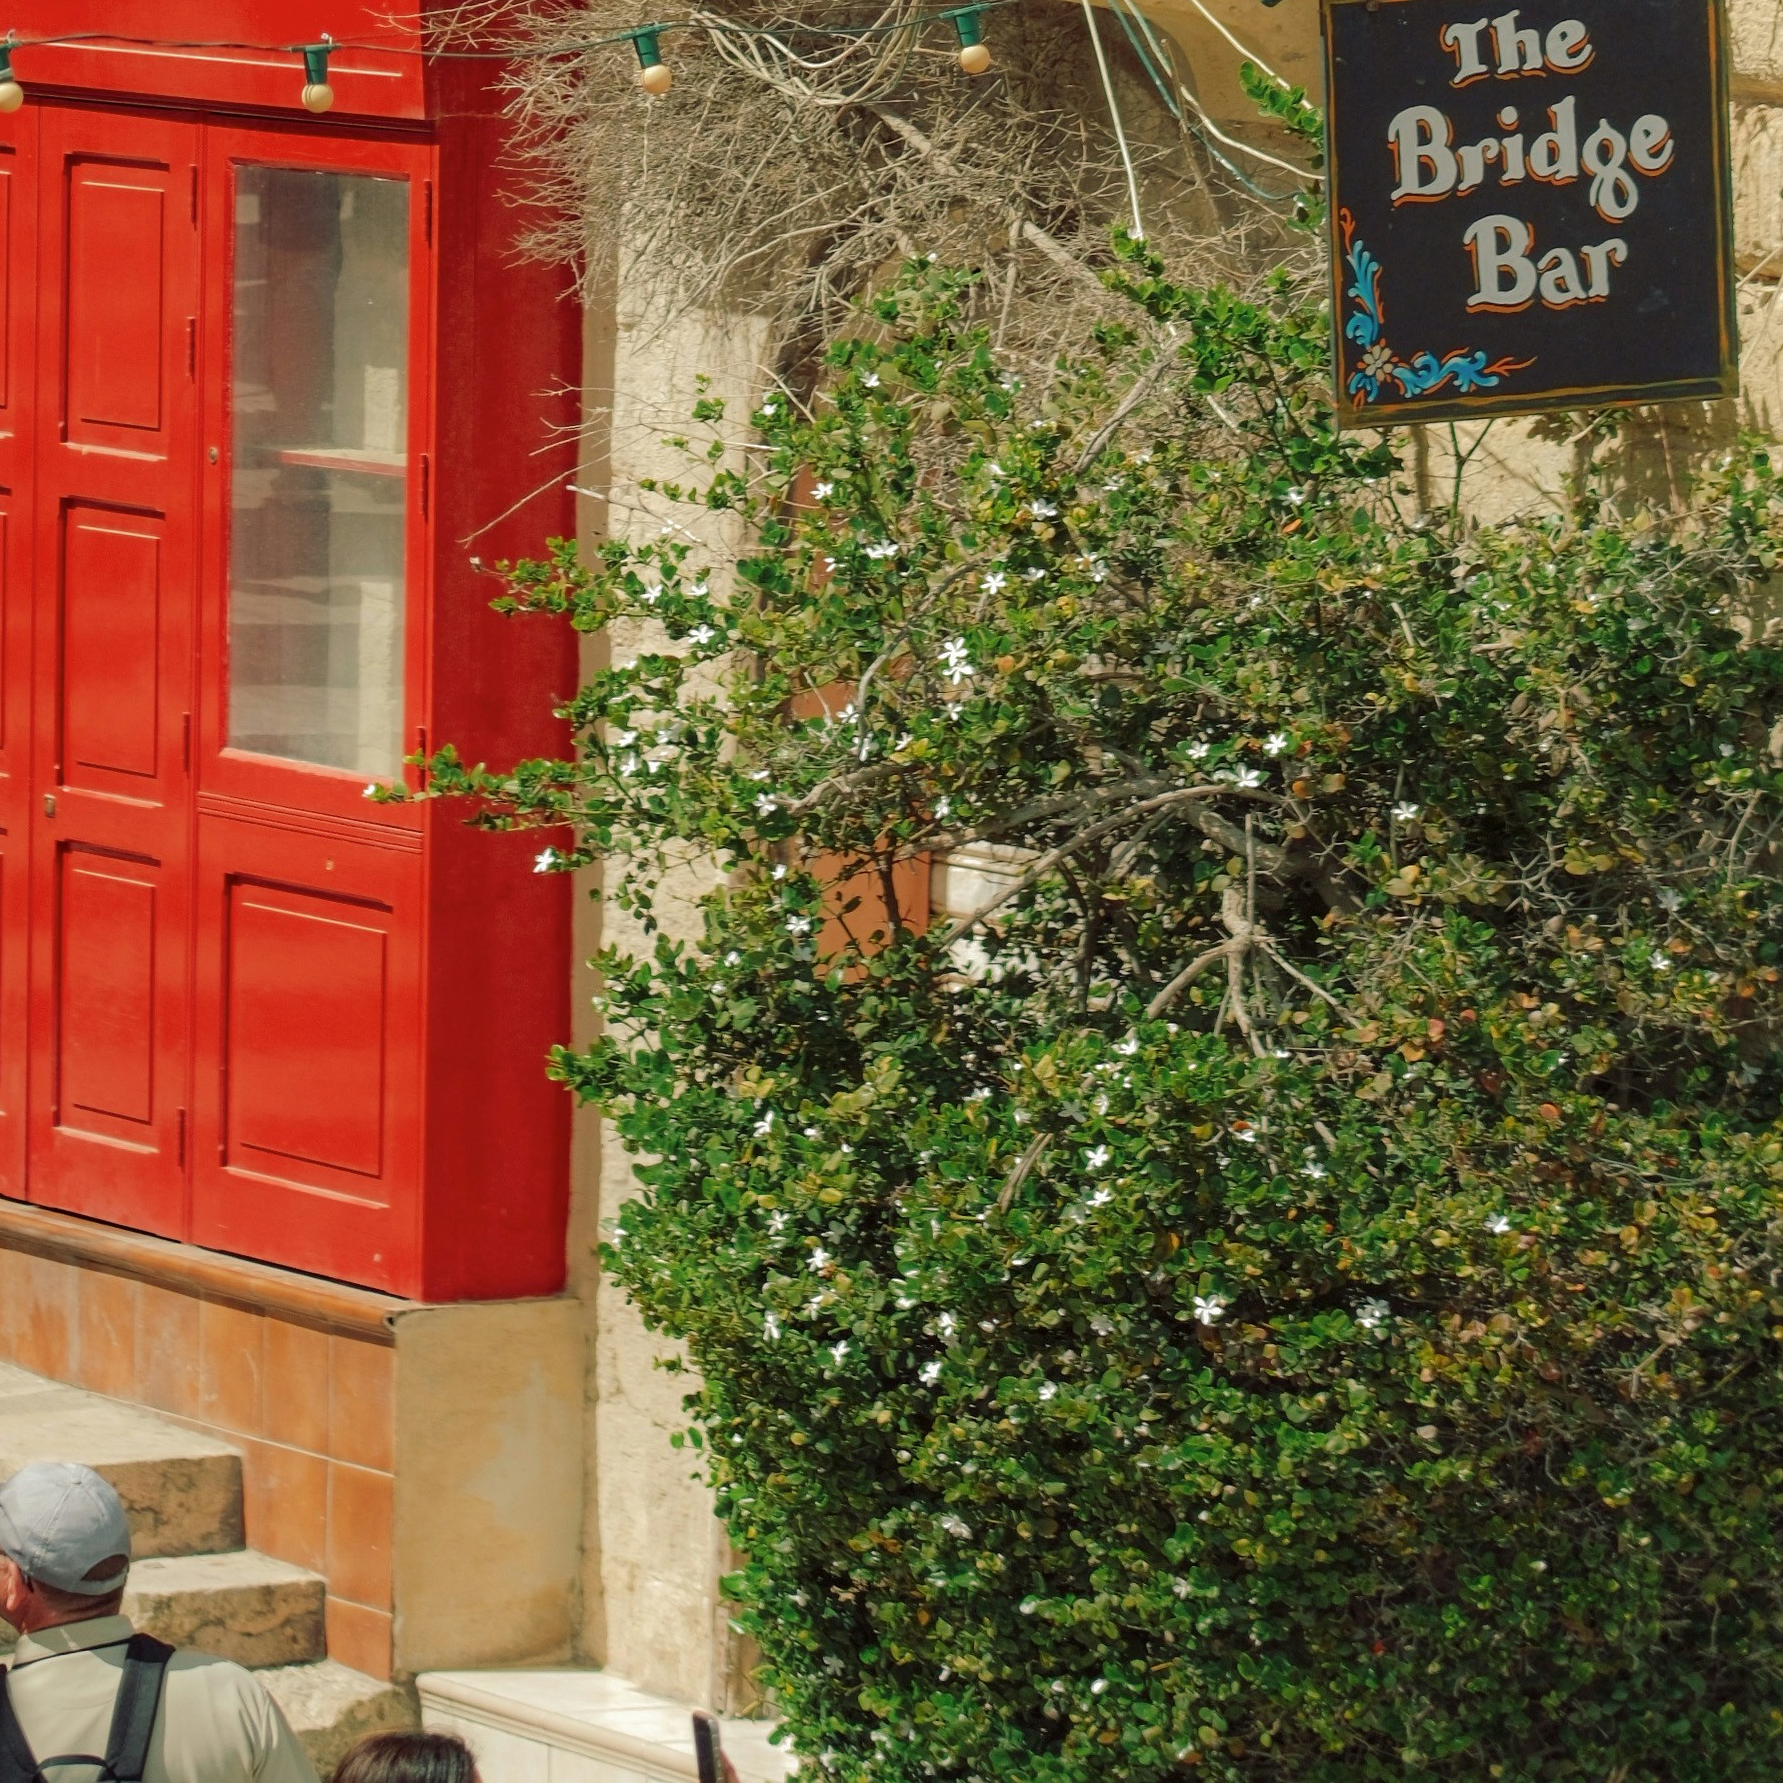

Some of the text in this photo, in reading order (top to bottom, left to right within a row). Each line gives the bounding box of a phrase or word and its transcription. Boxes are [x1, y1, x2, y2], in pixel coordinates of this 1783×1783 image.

[1442, 9, 1594, 85] The
[1388, 94, 1674, 221] Bridge
[1462, 214, 1629, 310] Bar
